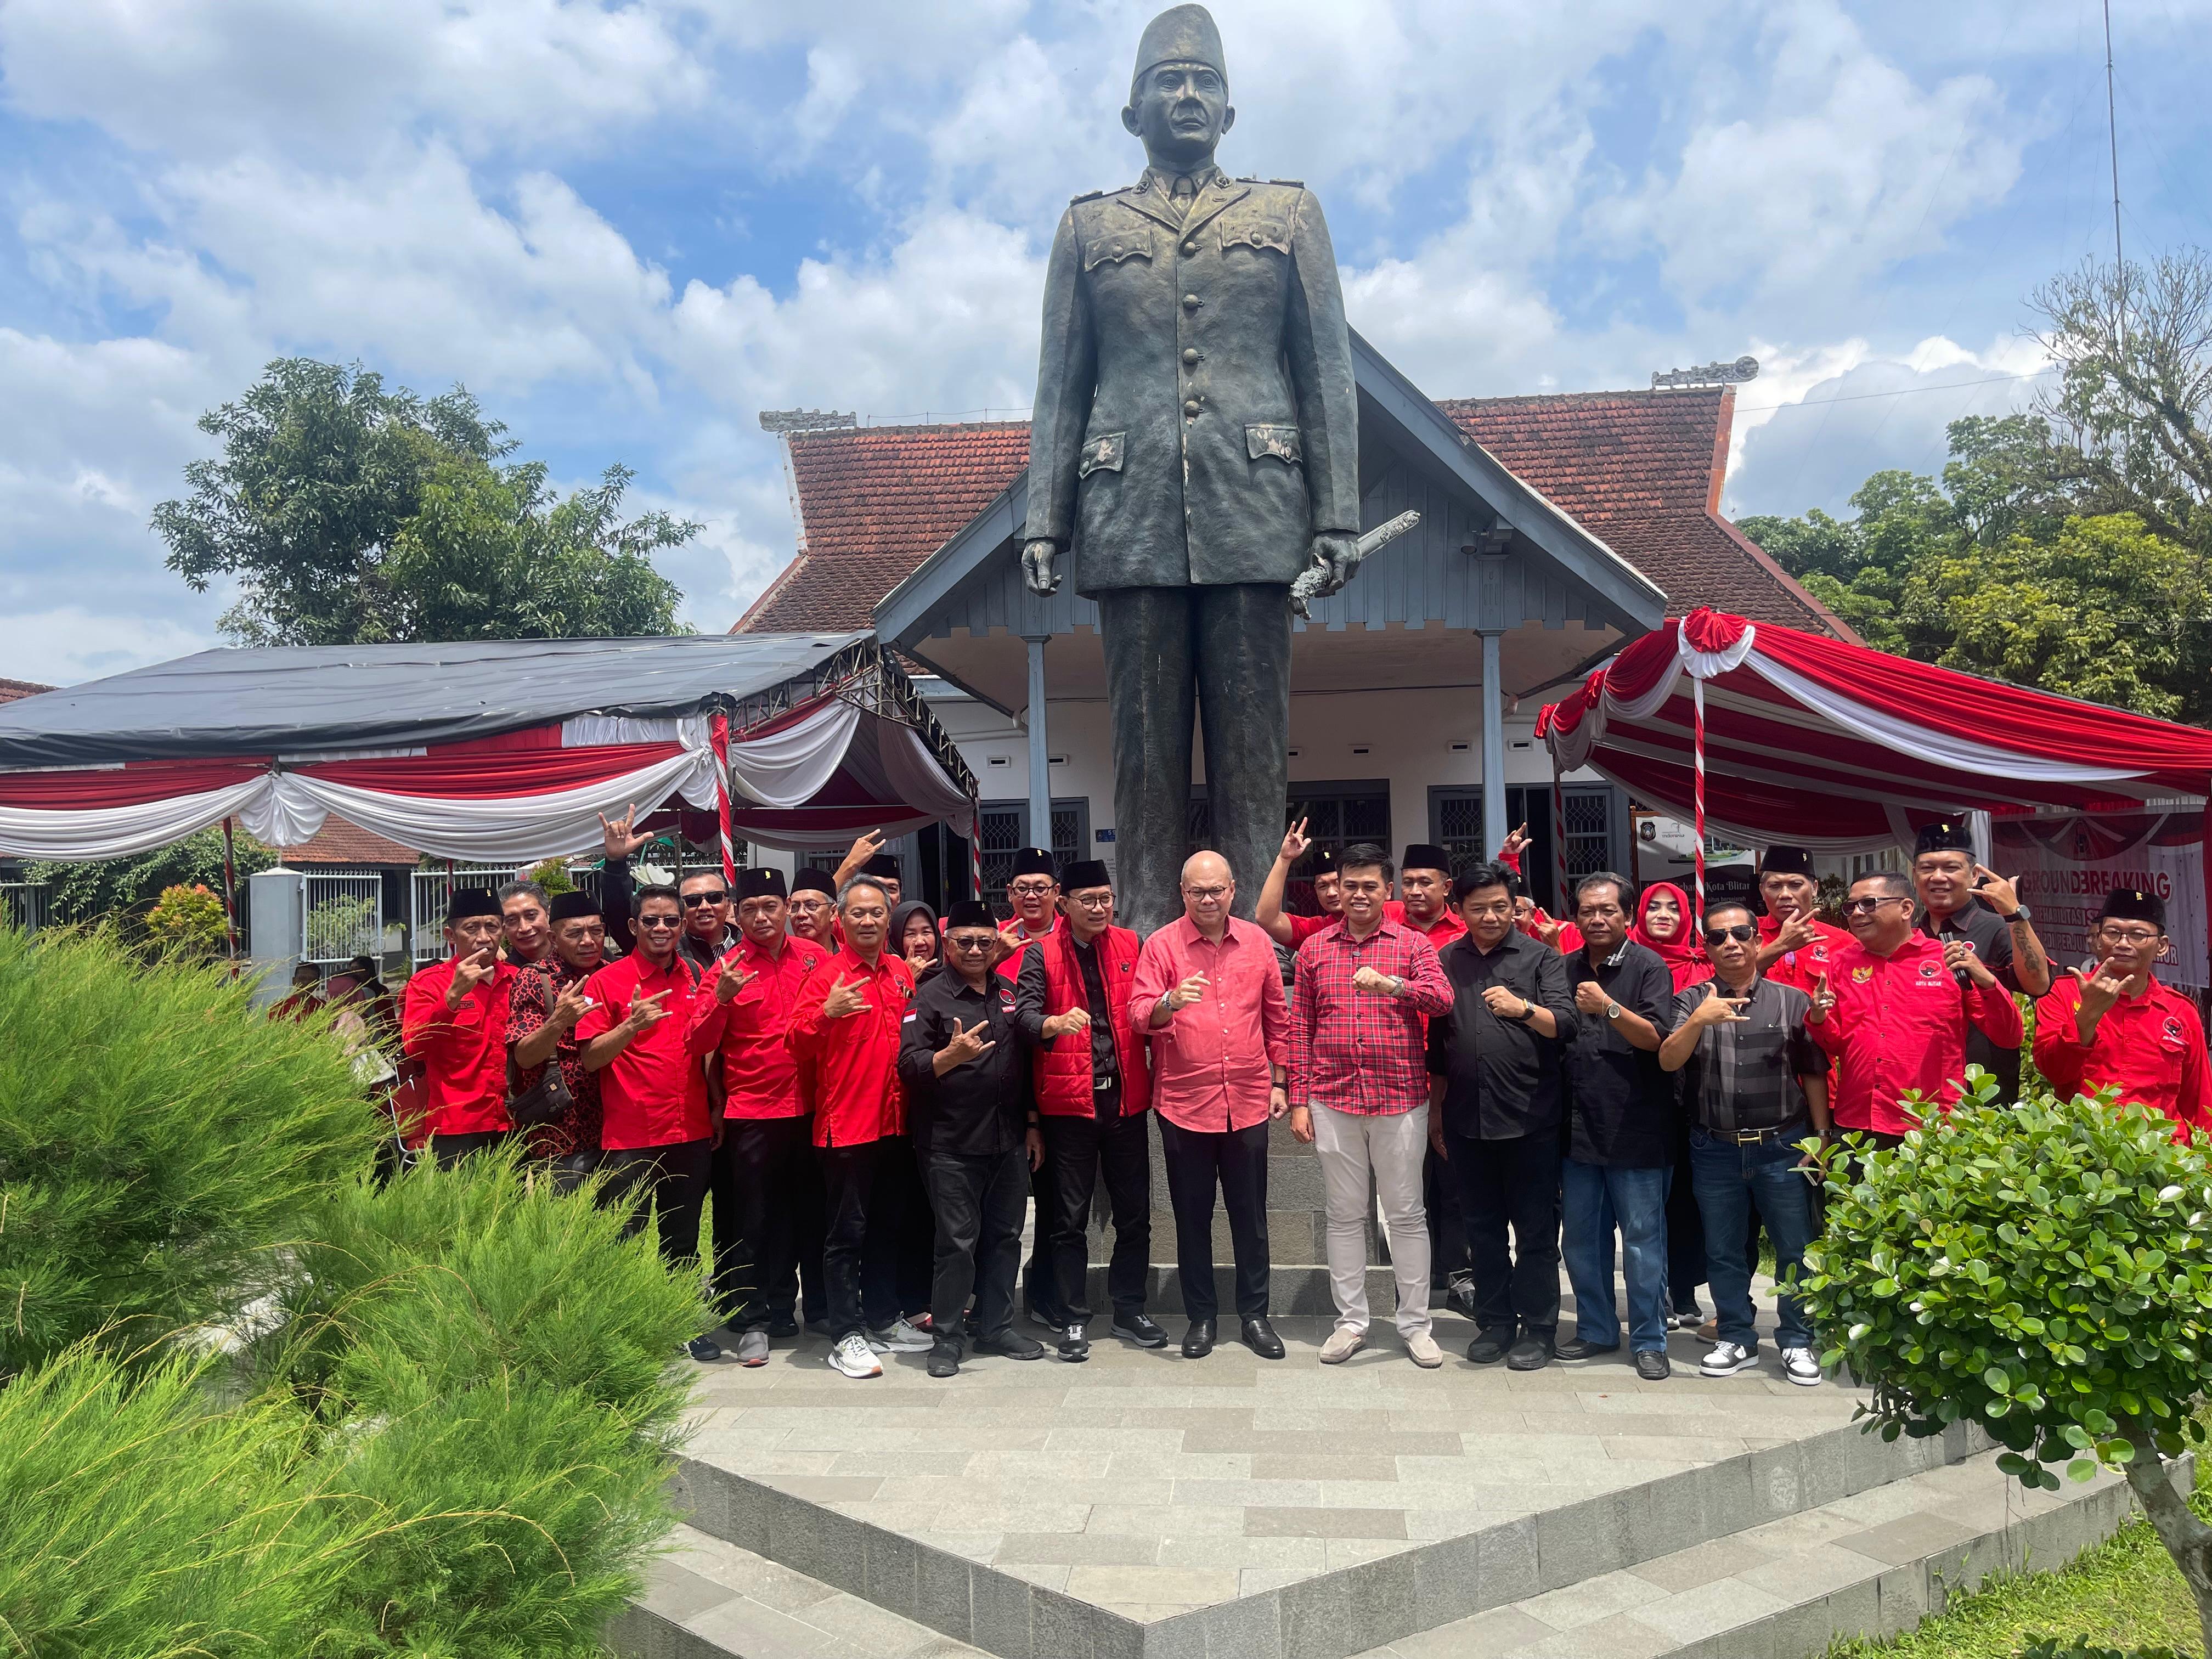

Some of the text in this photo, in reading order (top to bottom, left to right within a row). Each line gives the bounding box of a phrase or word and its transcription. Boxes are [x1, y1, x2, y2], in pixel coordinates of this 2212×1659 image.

[1705, 881, 1725, 893] Kota
[1726, 881, 1750, 891] Blitar
[2022, 870, 2171, 900] GROUNDBREAKING
[2034, 906, 2086, 926] REHABILITASI
